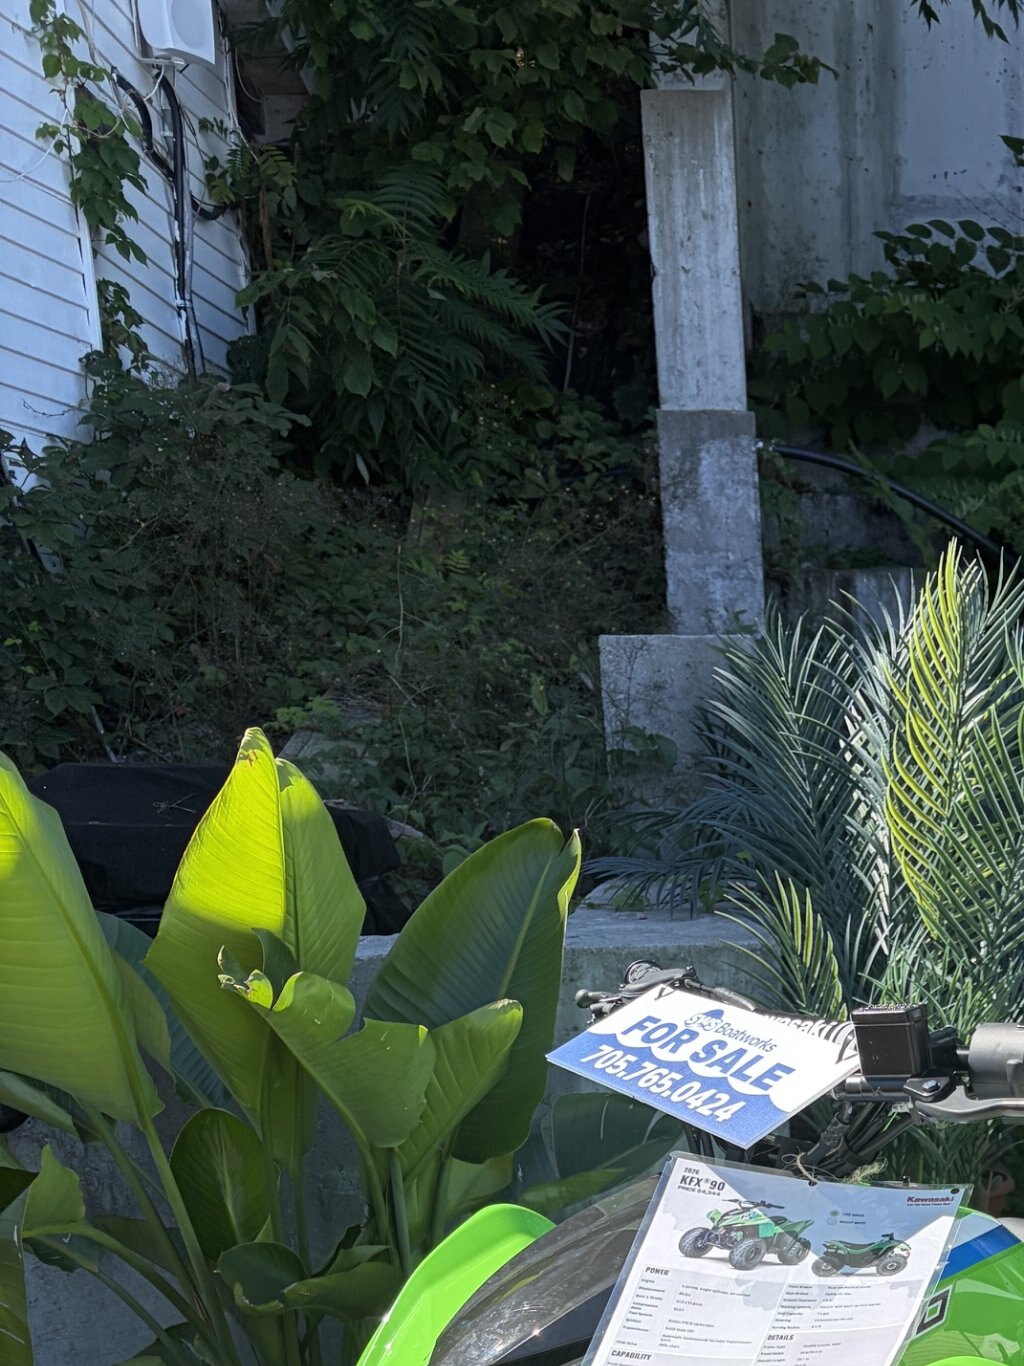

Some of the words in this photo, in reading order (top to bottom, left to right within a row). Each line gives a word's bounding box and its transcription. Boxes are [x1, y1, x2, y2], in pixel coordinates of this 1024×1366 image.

[714, 1021, 778, 1053] Boatworks
[620, 1015, 699, 1054] FOR
[689, 1038, 797, 1092] SALE
[580, 1044, 748, 1123] 705.765.0424
[906, 1195, 955, 1203] Kawasaki
[645, 1266, 670, 1277] POWER
[611, 1349, 653, 1361] CAPABILITY
